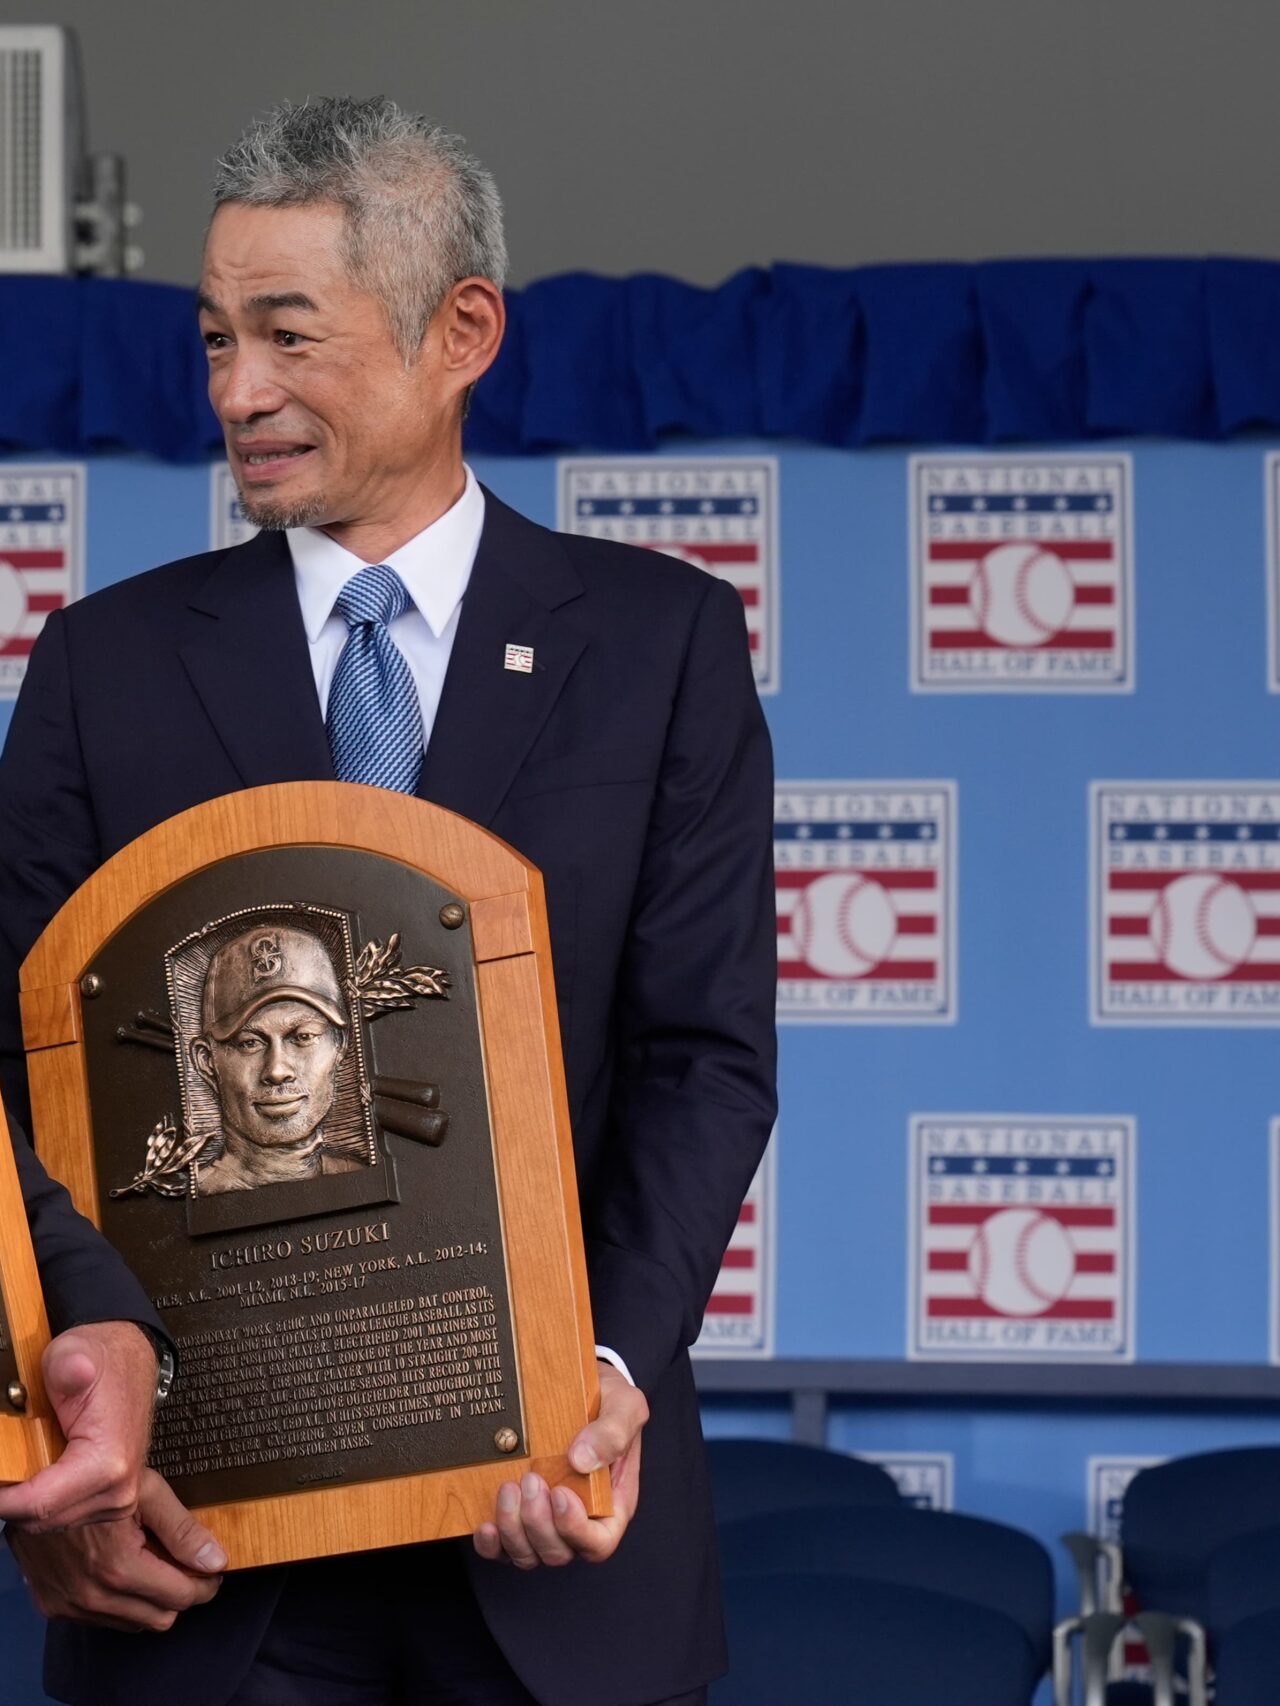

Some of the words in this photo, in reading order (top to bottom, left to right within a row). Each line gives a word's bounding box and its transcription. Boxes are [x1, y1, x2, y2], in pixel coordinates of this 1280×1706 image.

[576, 475, 758, 492] NATIONAL
[928, 470, 1114, 489] NATIONAL
[928, 517, 1114, 535] BASEBALL
[928, 655, 995, 672] HALL
[1004, 655, 1036, 672] OF
[1047, 655, 1114, 672] FAME
[775, 800, 939, 818] ATIONAL
[1108, 800, 1275, 818] NATIONA
[776, 847, 939, 864] ASEBALL
[1108, 848, 1274, 865] BASEBAL
[825, 986, 858, 1003] OF
[870, 986, 937, 1003] FAME
[1108, 988, 1173, 1005] HALL
[1184, 988, 1217, 1005] OF
[1229, 988, 1280, 1005] FAM
[928, 1131, 1116, 1152] NATIONAL
[928, 1182, 1116, 1199] BASEBALL
[210, 1238, 292, 1269] ICHIRO
[299, 1221, 390, 1254] SUZUKI
[323, 1263, 354, 1281] NEW
[357, 1255, 401, 1275] YORK,
[403, 1250, 430, 1267] A.L.
[433, 1240, 488, 1262] 2012-14;
[239, 1288, 286, 1308] MIAMI,
[319, 1274, 366, 1294] 2015-17
[309, 1311, 330, 1327] AND
[334, 1297, 414, 1322] UNPARALLELED
[417, 1293, 438, 1309] BAT
[441, 1284, 493, 1305] CONTROL,
[320, 1325, 332, 1339] TO
[334, 1319, 367, 1337] MAJOR
[368, 1312, 410, 1331] LEAGUE
[411, 1304, 462, 1324] BASEBALL
[463, 1301, 477, 1316] AS
[477, 1298, 495, 1313] ITS
[333, 1328, 399, 1351] ELECTRIFIED
[401, 1324, 423, 1340] 2001
[426, 1315, 479, 1336] MARINERS
[482, 1312, 496, 1327] TO
[704, 1323, 754, 1339] AME
[926, 1325, 990, 1342] HALL
[1001, 1325, 1033, 1343] OF
[1045, 1325, 1115, 1343] FAME
[337, 1346, 376, 1365] ROOKIE
[376, 1343, 391, 1358] OF
[393, 1340, 414, 1356] THE
[415, 1335, 444, 1352] YEAR
[445, 1331, 468, 1347] AND
[469, 1326, 498, 1343] MOST
[292, 1369, 320, 1386] ONLY
[323, 1363, 362, 1381] PLAYER
[364, 1358, 391, 1375] WITH
[394, 1356, 404, 1370] 10
[407, 1347, 458, 1368] STRAIGHT
[460, 1341, 499, 1359] 200-HIT
[319, 1371, 397, 1396] SINGLE-SEASON
[401, 1367, 425, 1383] HITS
[428, 1360, 470, 1379] RECORD
[473, 1355, 501, 1371] WITH
[310, 1394, 344, 1412] GLOVE
[346, 1384, 409, 1406] OUTFIELDER
[412, 1372, 483, 1396] THROUGHOUT
[484, 1369, 503, 1384] HIS
[325, 1410, 337, 1424] IN
[339, 1406, 362, 1422] HITS
[362, 1401, 396, 1418] SEVEN
[398, 1395, 432, 1412] TIMES.
[433, 1391, 457, 1407] WON
[459, 1387, 482, 1403] TWO
[482, 1383, 504, 1399] A.L.
[331, 1420, 364, 1438] SEVEN
[371, 1408, 441, 1431] CONSECUTIVE
[449, 1405, 462, 1419] IN
[468, 1398, 505, 1416] JAPAN.
[299, 1438, 337, 1456] STOLEN
[339, 1432, 373, 1450] BASES.
